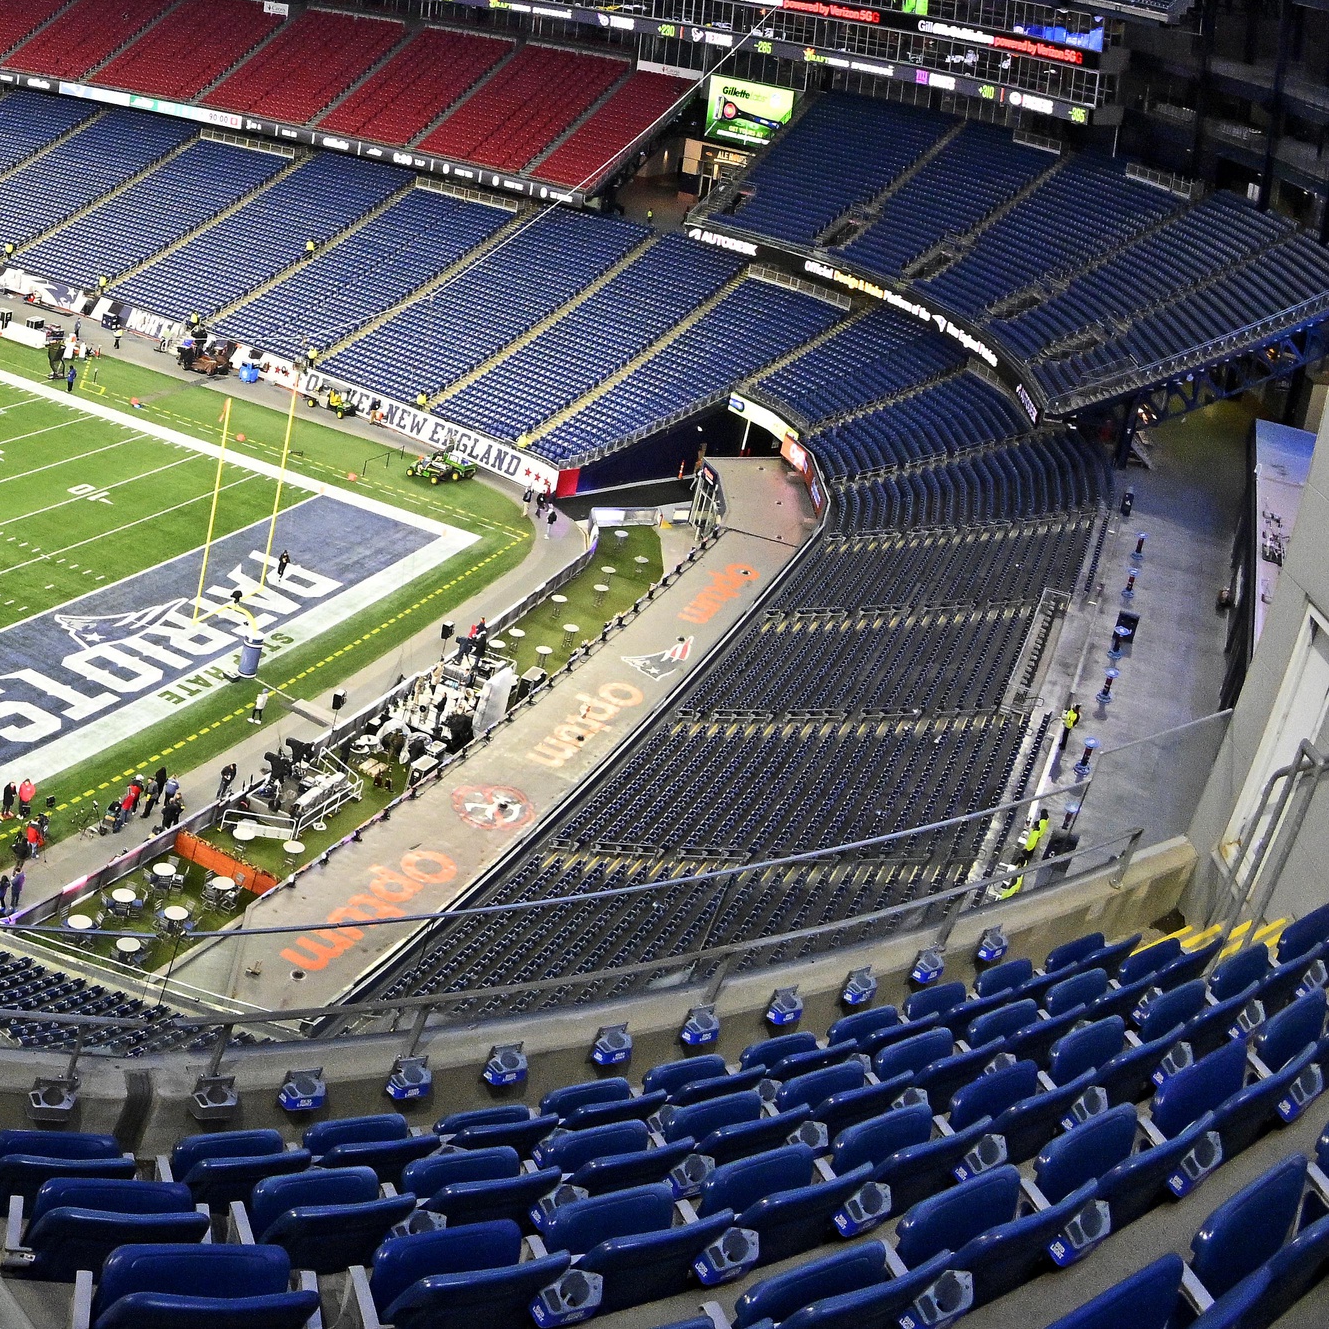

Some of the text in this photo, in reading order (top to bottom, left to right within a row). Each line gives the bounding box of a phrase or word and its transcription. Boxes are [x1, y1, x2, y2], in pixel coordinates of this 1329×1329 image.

[818, 2, 830, 17] by
[829, 4, 860, 19] Verizon
[753, 41, 772, 54] -285
[994, 35, 1065, 59] powered by Verizon
[717, 150, 729, 160] ALE
[384, 405, 522, 477] NEW ENGLAND
[67, 483, 110, 501] 10
[676, 562, 760, 625] optum
[525, 681, 644, 768] optum
[279, 849, 458, 971] optum
